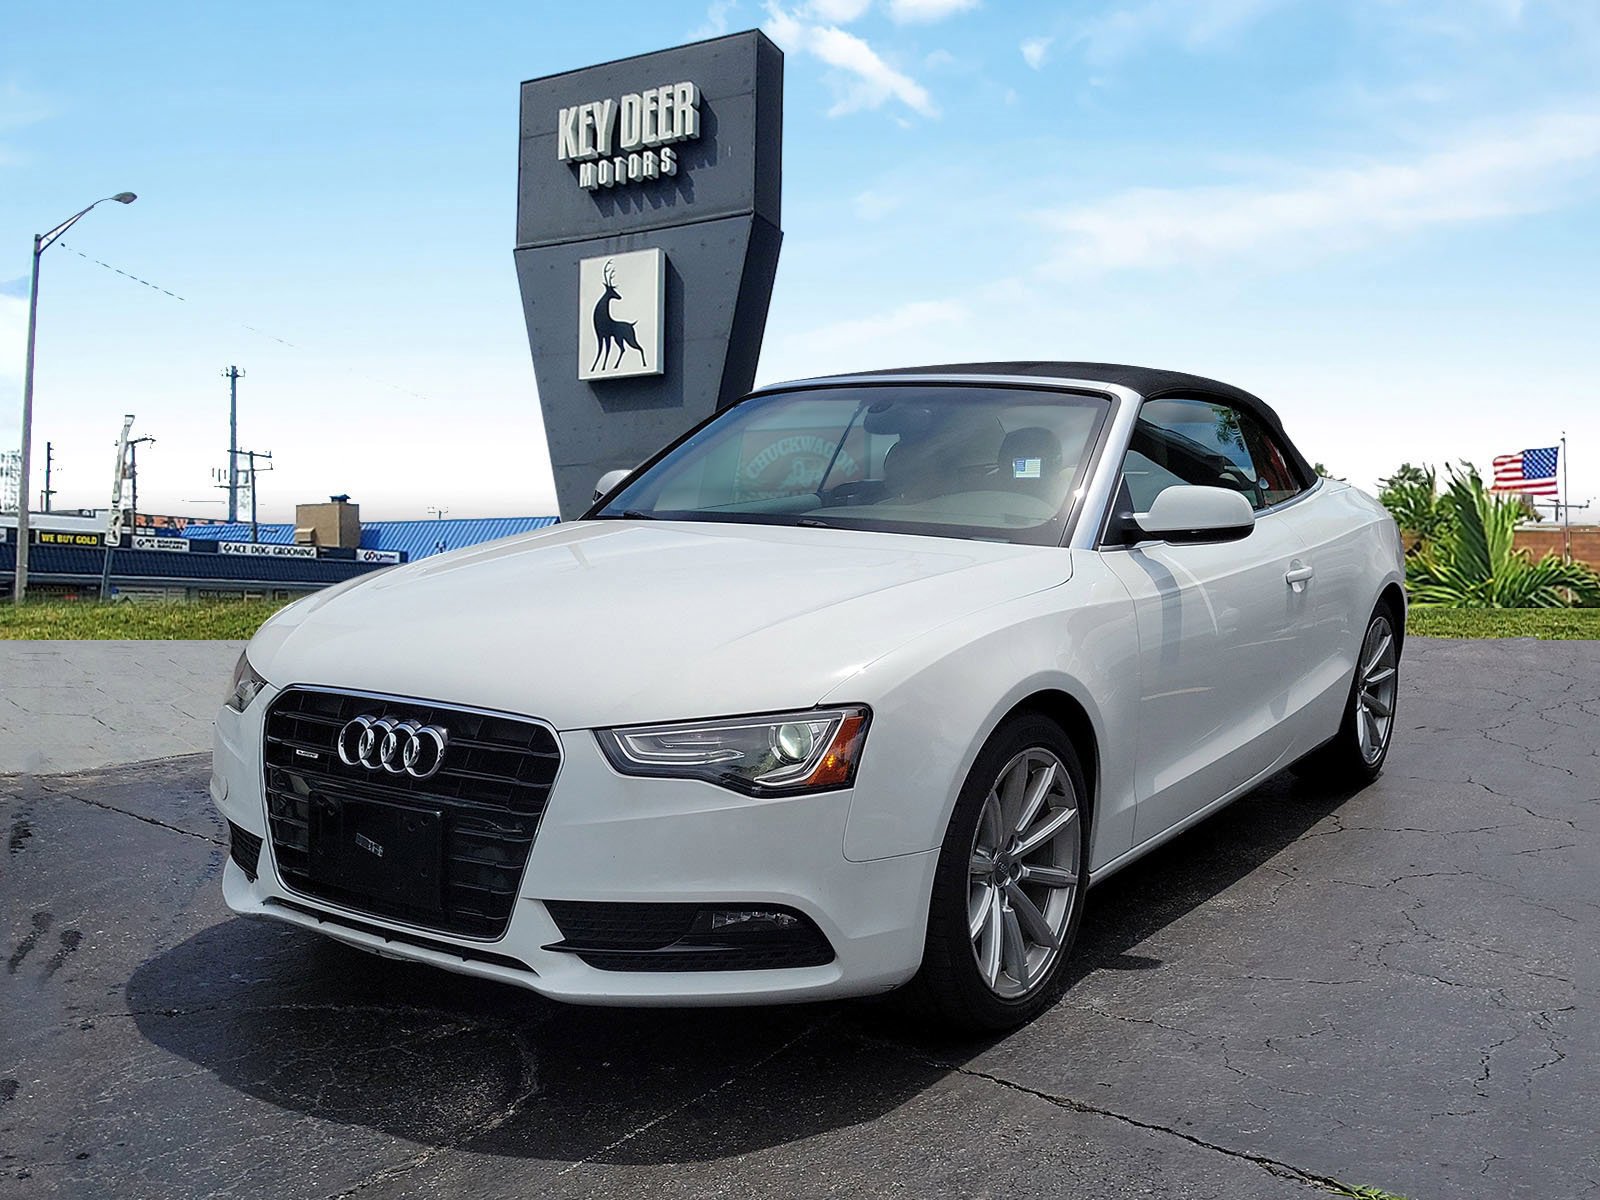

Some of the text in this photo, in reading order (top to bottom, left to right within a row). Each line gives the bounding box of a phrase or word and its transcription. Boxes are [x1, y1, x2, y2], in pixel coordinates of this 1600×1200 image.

[558, 81, 700, 161] KEY DEER
[579, 147, 677, 190] MOTORS
[41, 533, 97, 545] WE BUY GOLD
[233, 545, 314, 557] ACE DOG GROOMING
